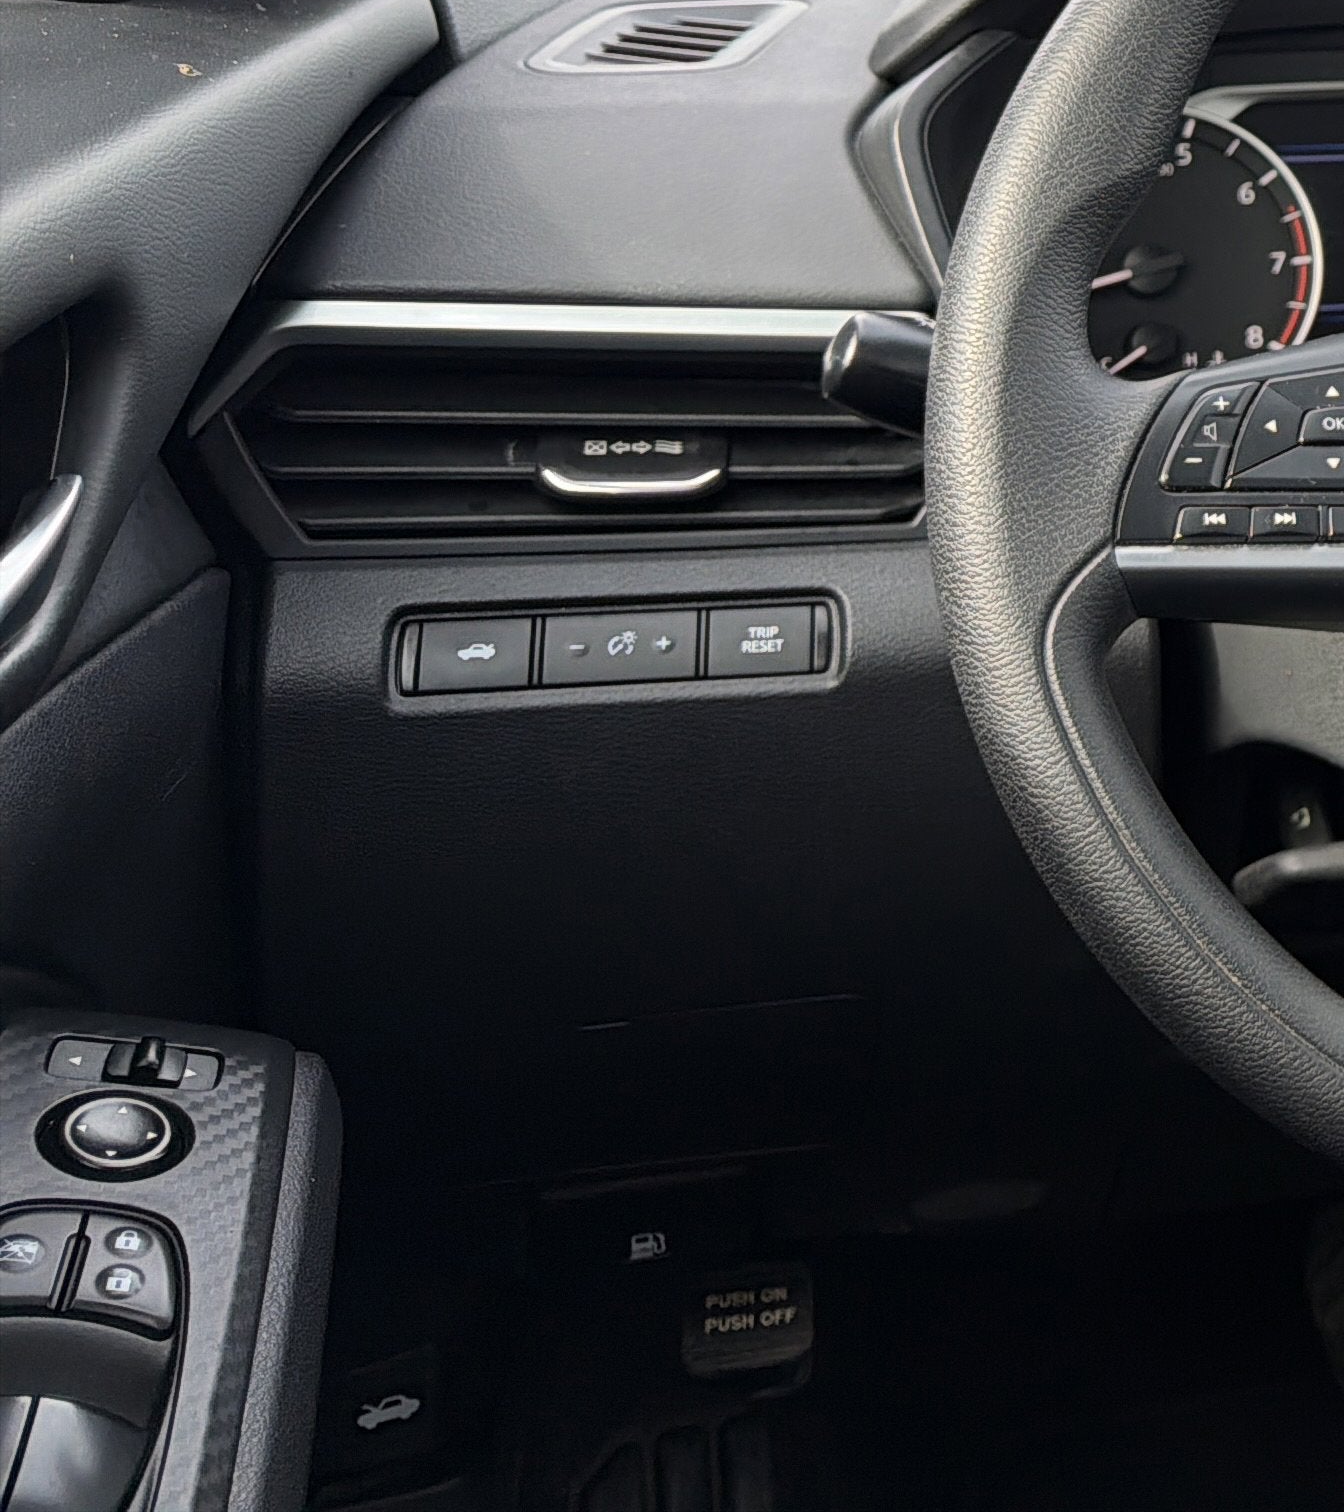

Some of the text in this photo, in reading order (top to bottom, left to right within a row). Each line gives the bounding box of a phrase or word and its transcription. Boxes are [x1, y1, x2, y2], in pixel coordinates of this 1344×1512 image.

[1174, 142, 1193, 167] 5
[1236, 181, 1256, 206] 6
[1268, 250, 1287, 275] 7
[1244, 324, 1264, 350] 8
[748, 625, 779, 639] TRIP
[741, 638, 785, 655] RESET
[706, 1287, 788, 1310] PUSH ON
[705, 1306, 797, 1334] PUSH OFF
